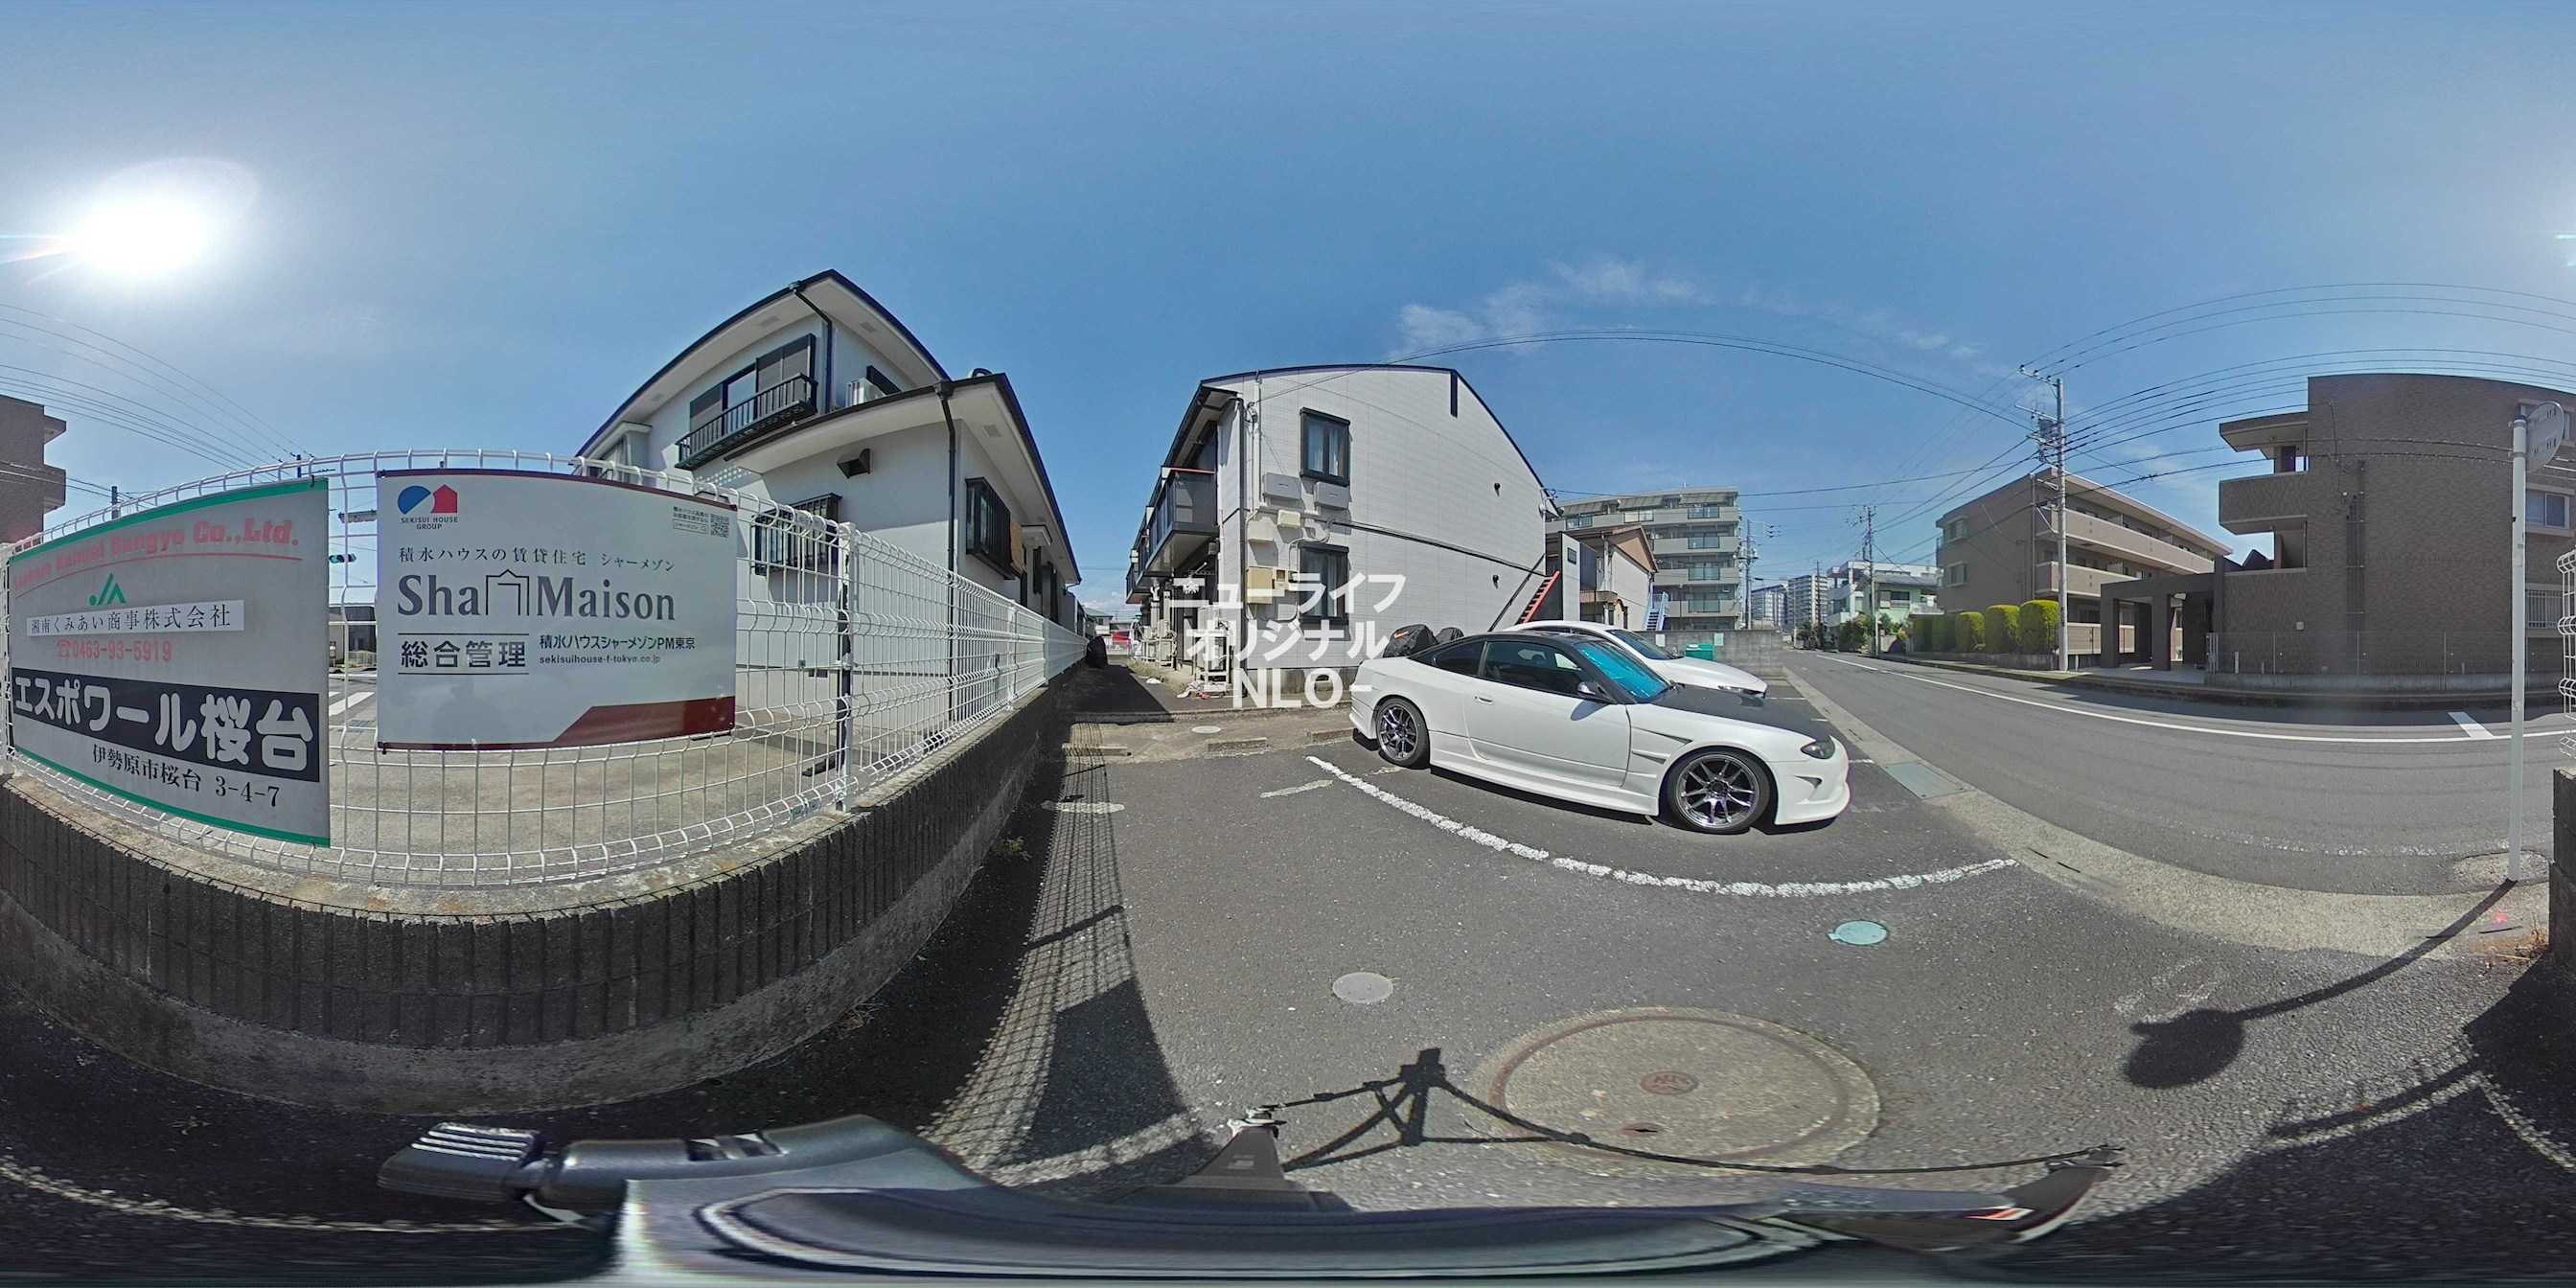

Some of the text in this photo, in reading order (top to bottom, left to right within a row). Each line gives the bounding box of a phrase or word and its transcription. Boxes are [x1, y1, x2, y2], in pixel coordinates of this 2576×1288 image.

[399, 546, 676, 572] 積水ハウスの賃貸住宅 シャーメゾン
[398, 575, 676, 621] Sha Maison
[31, 603, 231, 633] 湘南くみあい商事株式会社
[401, 640, 526, 668] 総合管理
[539, 633, 696, 651] 積水ハウスシャーメゾンPM東京
[15, 677, 312, 770] エスポワール桜台
[92, 744, 281, 808] 伊勢原市桜台 3-4-7
